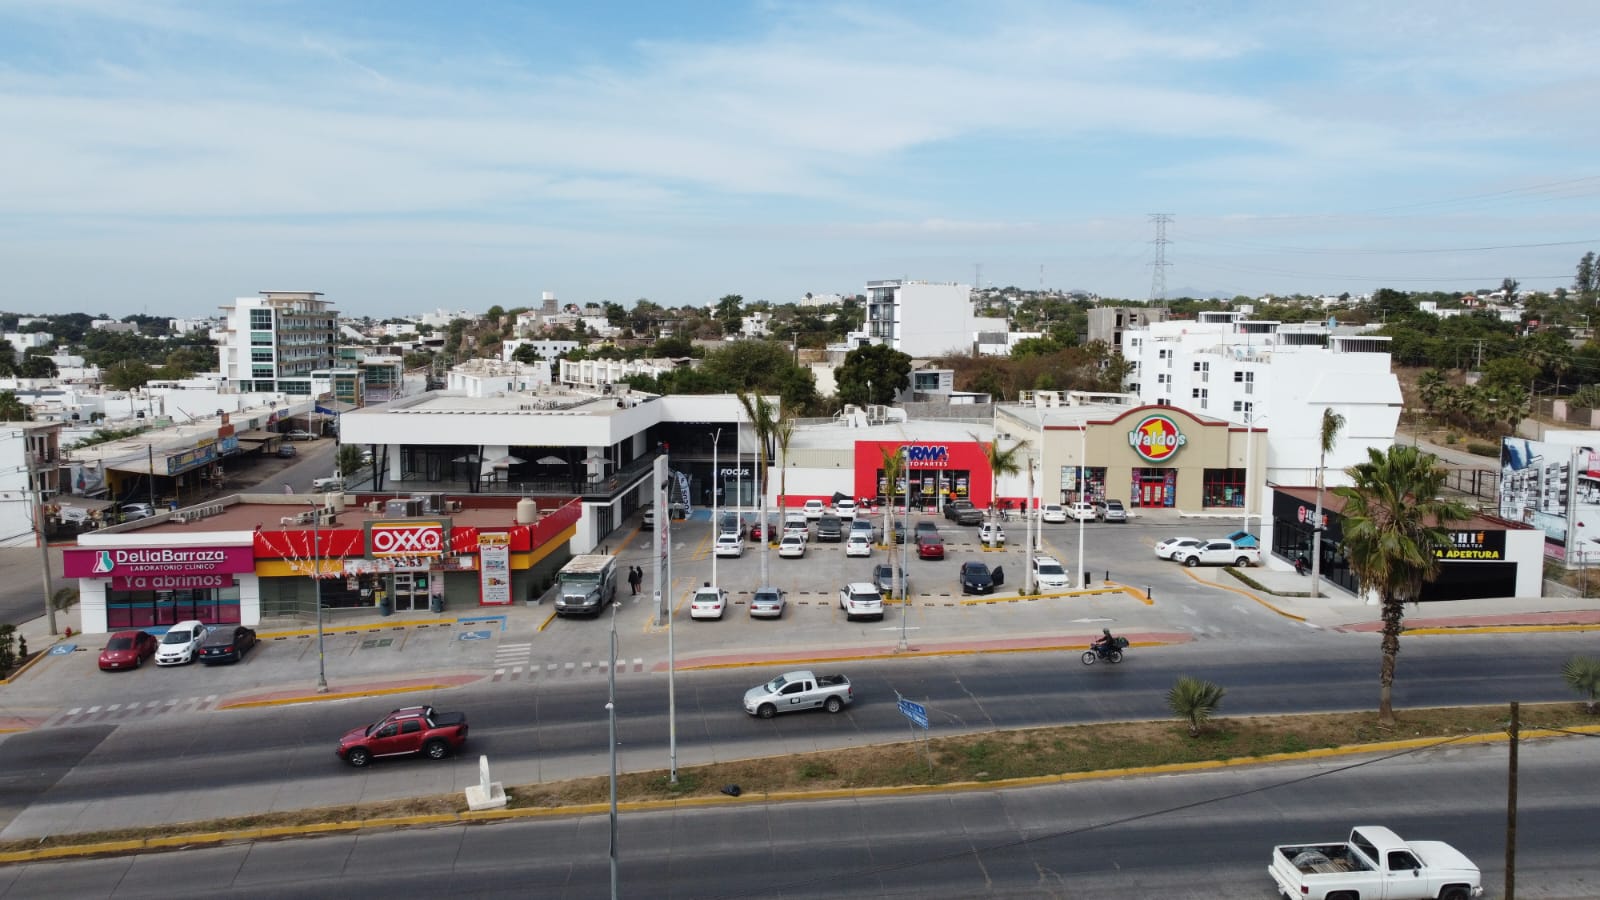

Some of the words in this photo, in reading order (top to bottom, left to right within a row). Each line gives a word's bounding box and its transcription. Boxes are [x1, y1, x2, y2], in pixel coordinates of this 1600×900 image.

[1129, 431, 1186, 446] Waldo's
[374, 530, 440, 552] OXXO
[116, 550, 224, 562] DeliaBarraza
[1446, 550, 1499, 558] APERTURA
[125, 576, 147, 588] Ya
[152, 575, 223, 588] abrimos
